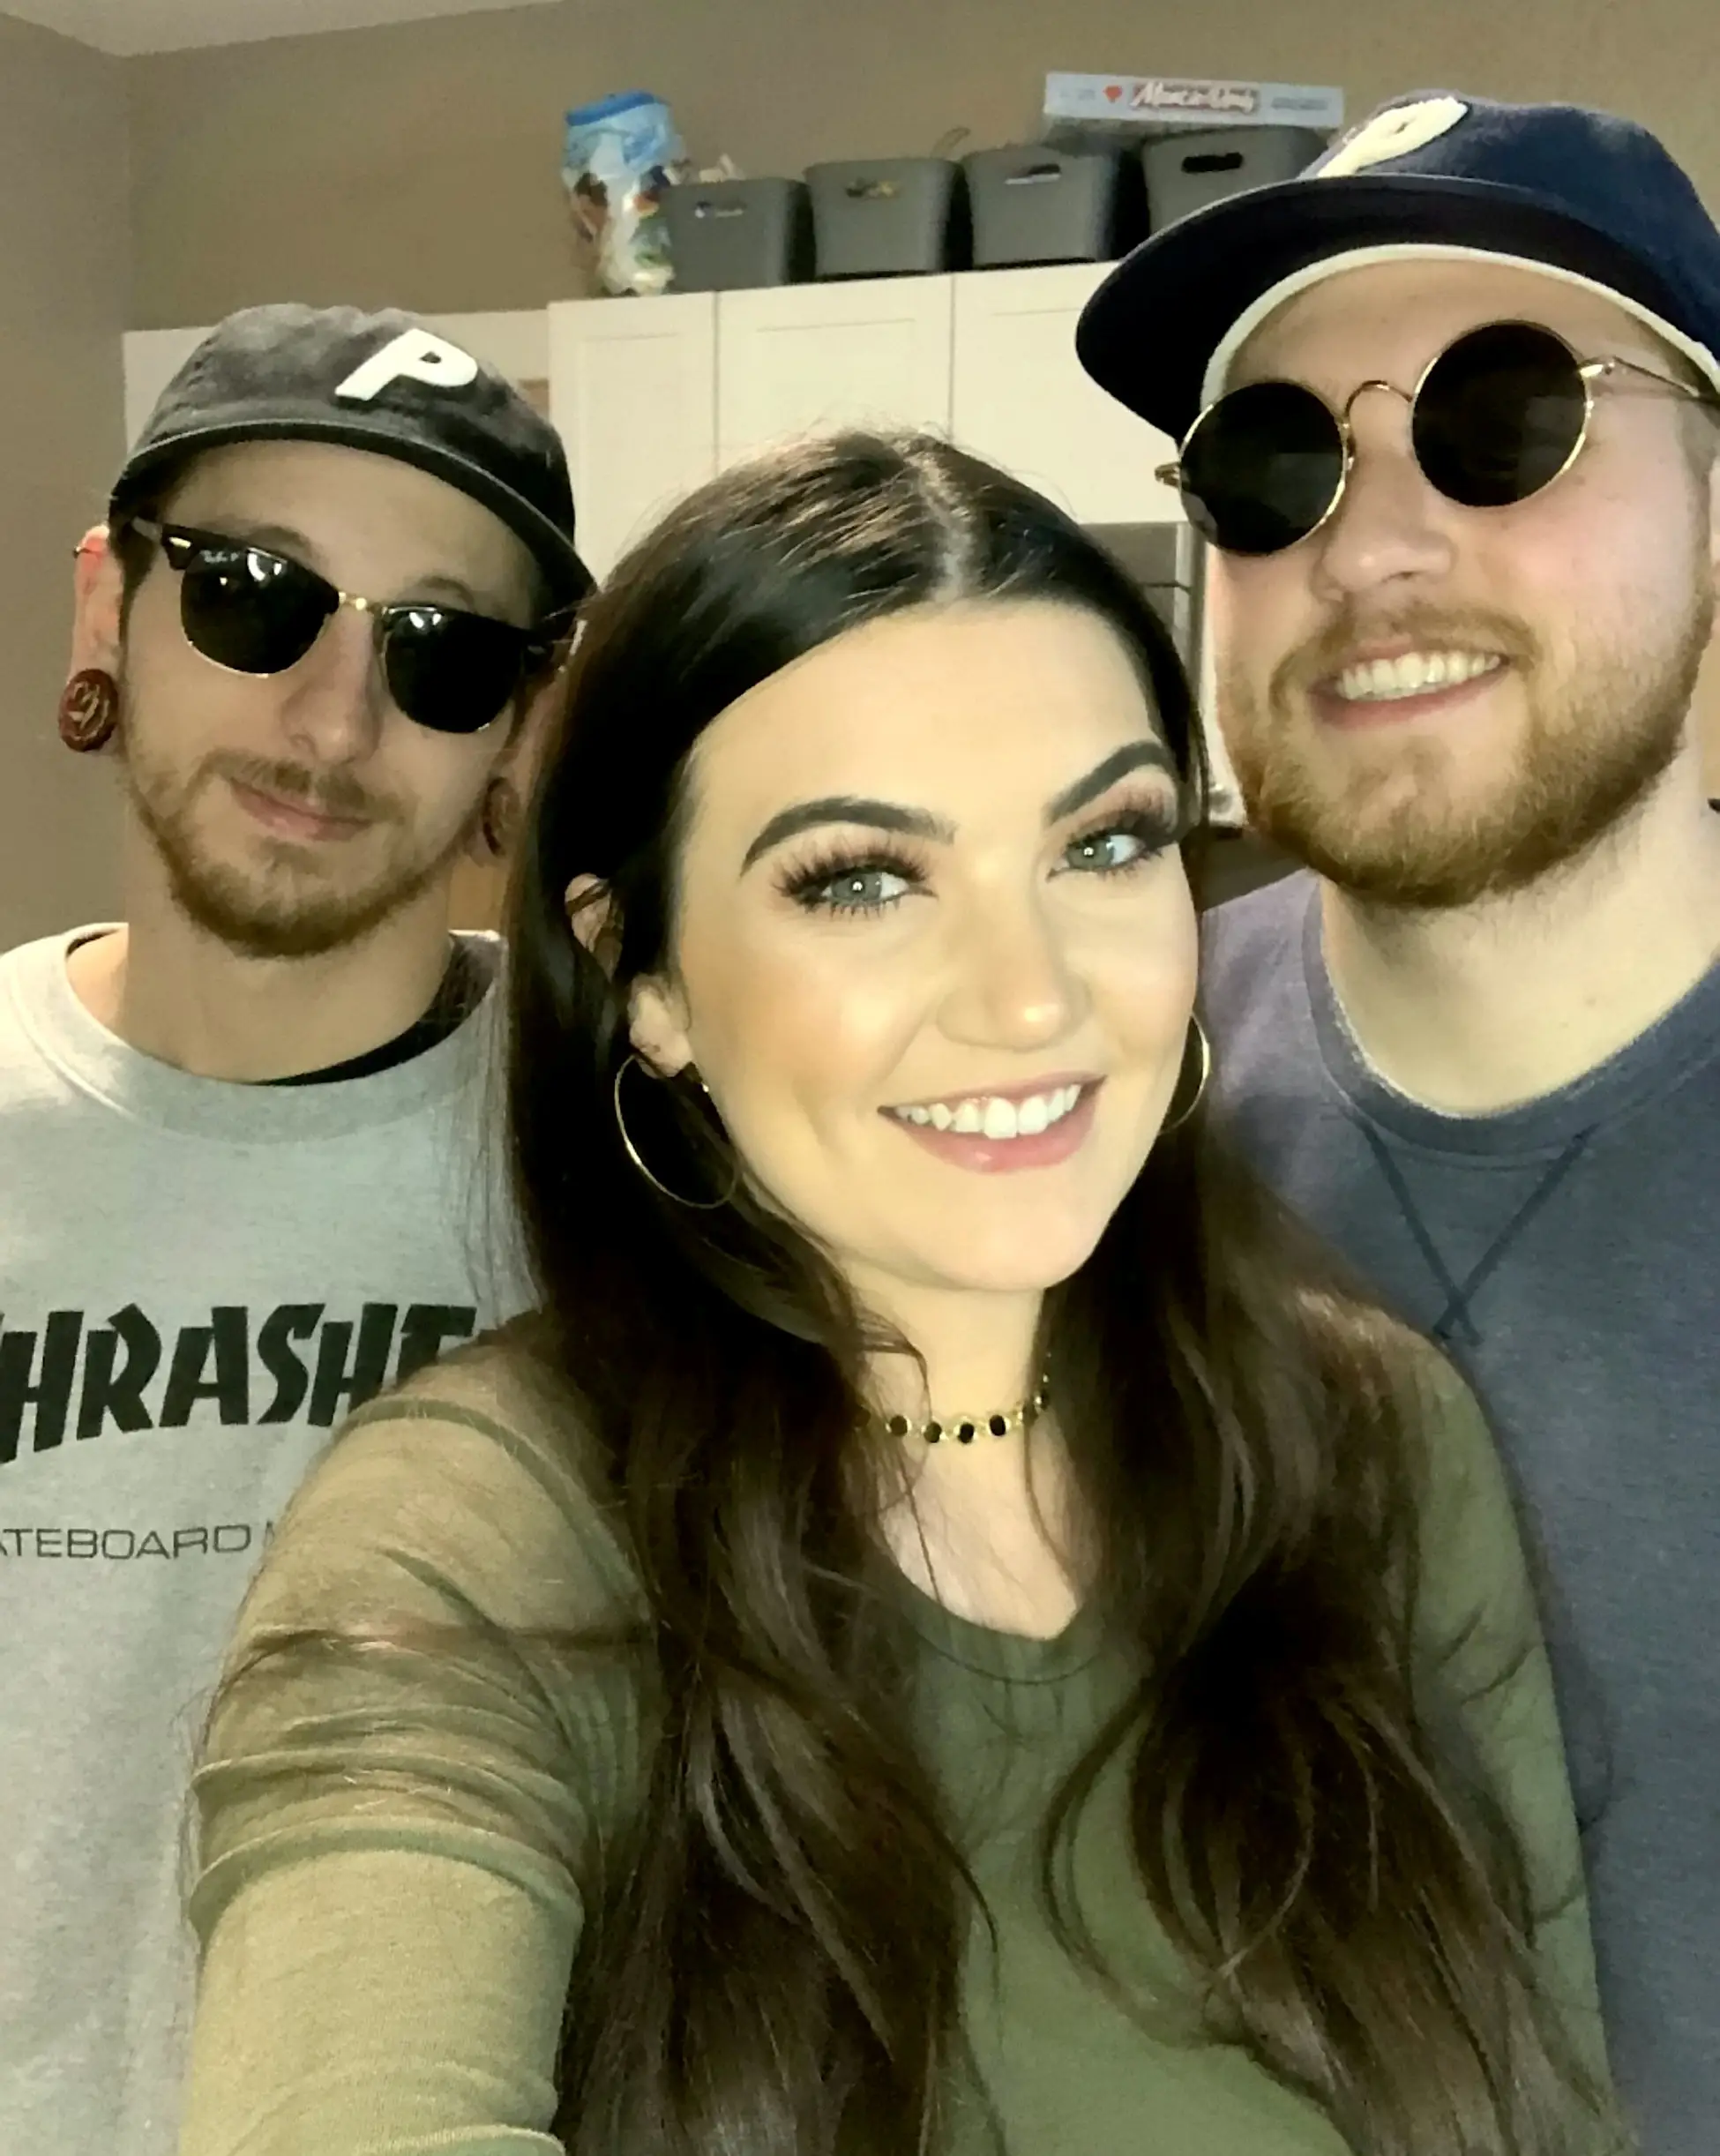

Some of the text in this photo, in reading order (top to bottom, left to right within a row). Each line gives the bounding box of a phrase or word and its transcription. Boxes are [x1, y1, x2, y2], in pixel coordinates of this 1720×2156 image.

[1316, 95, 1468, 177] P
[334, 328, 478, 401] P
[0, 1303, 477, 1464] HRASH
